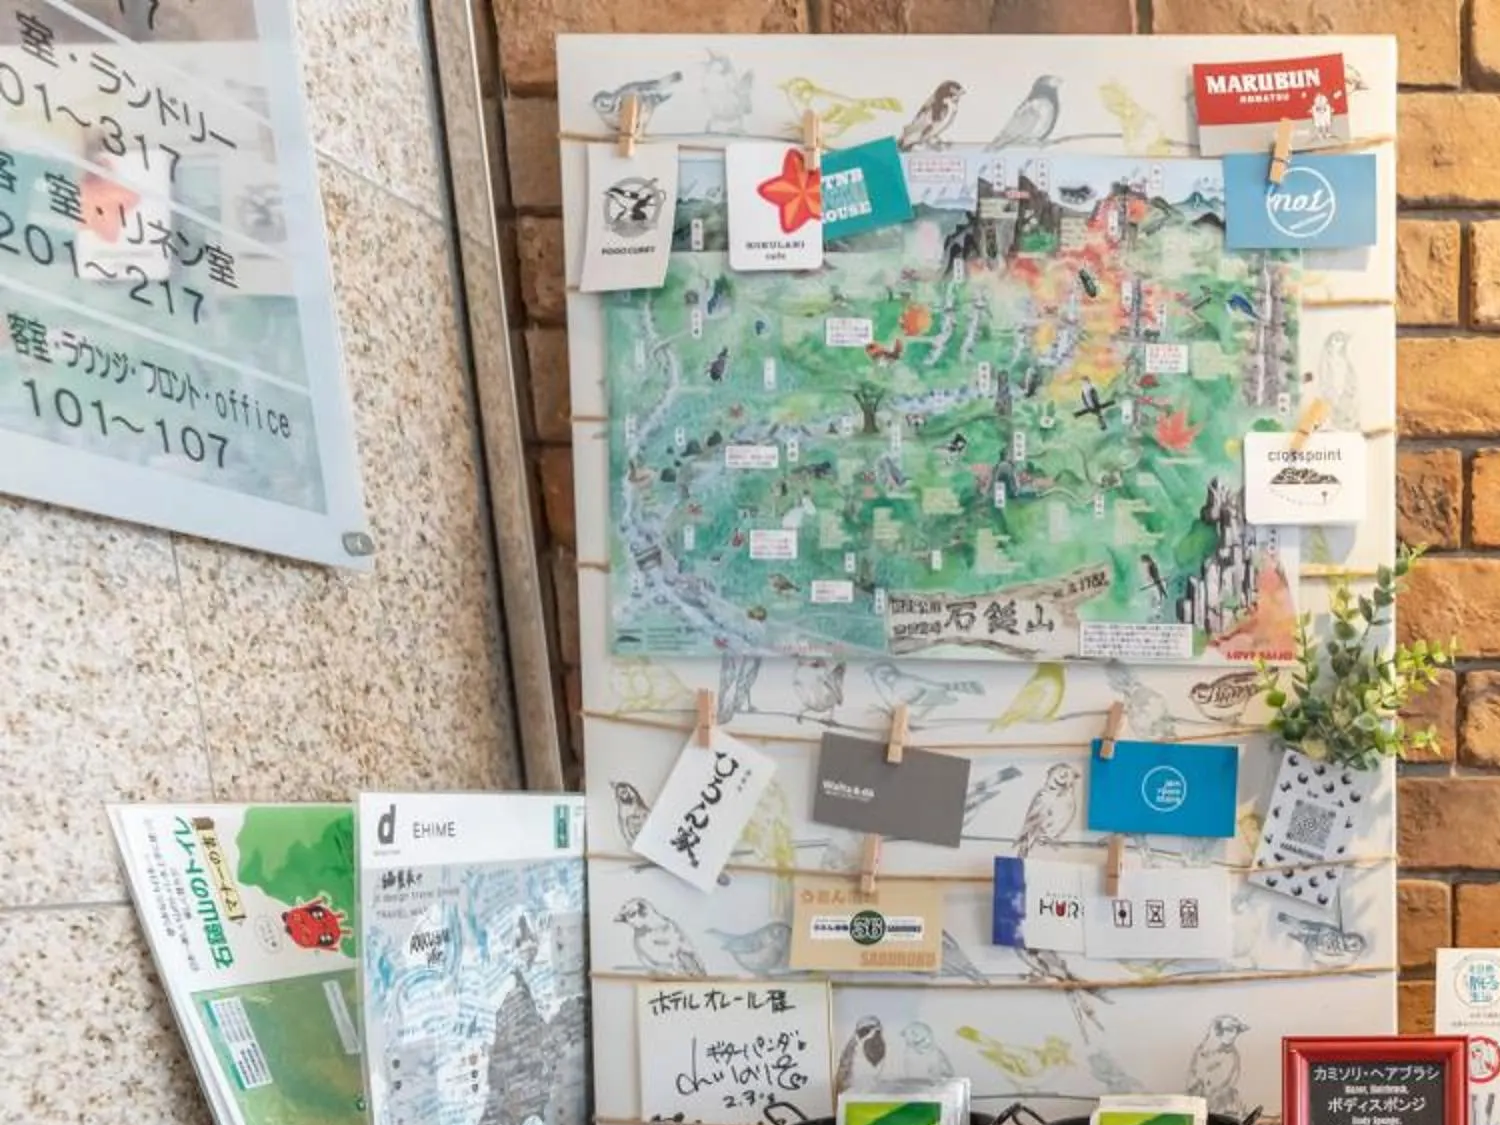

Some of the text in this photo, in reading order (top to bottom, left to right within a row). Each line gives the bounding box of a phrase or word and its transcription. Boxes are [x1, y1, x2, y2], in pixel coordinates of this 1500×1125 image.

[1205, 68, 1321, 94] MARUBUN
[1267, 449, 1343, 463] crosspoint
[377, 804, 396, 844] d
[413, 821, 457, 838] EHIME
[1313, 1065, 1440, 1081] カミソリ・ヘアブラシ
[1327, 1096, 1426, 1112] ボディスポンジ
